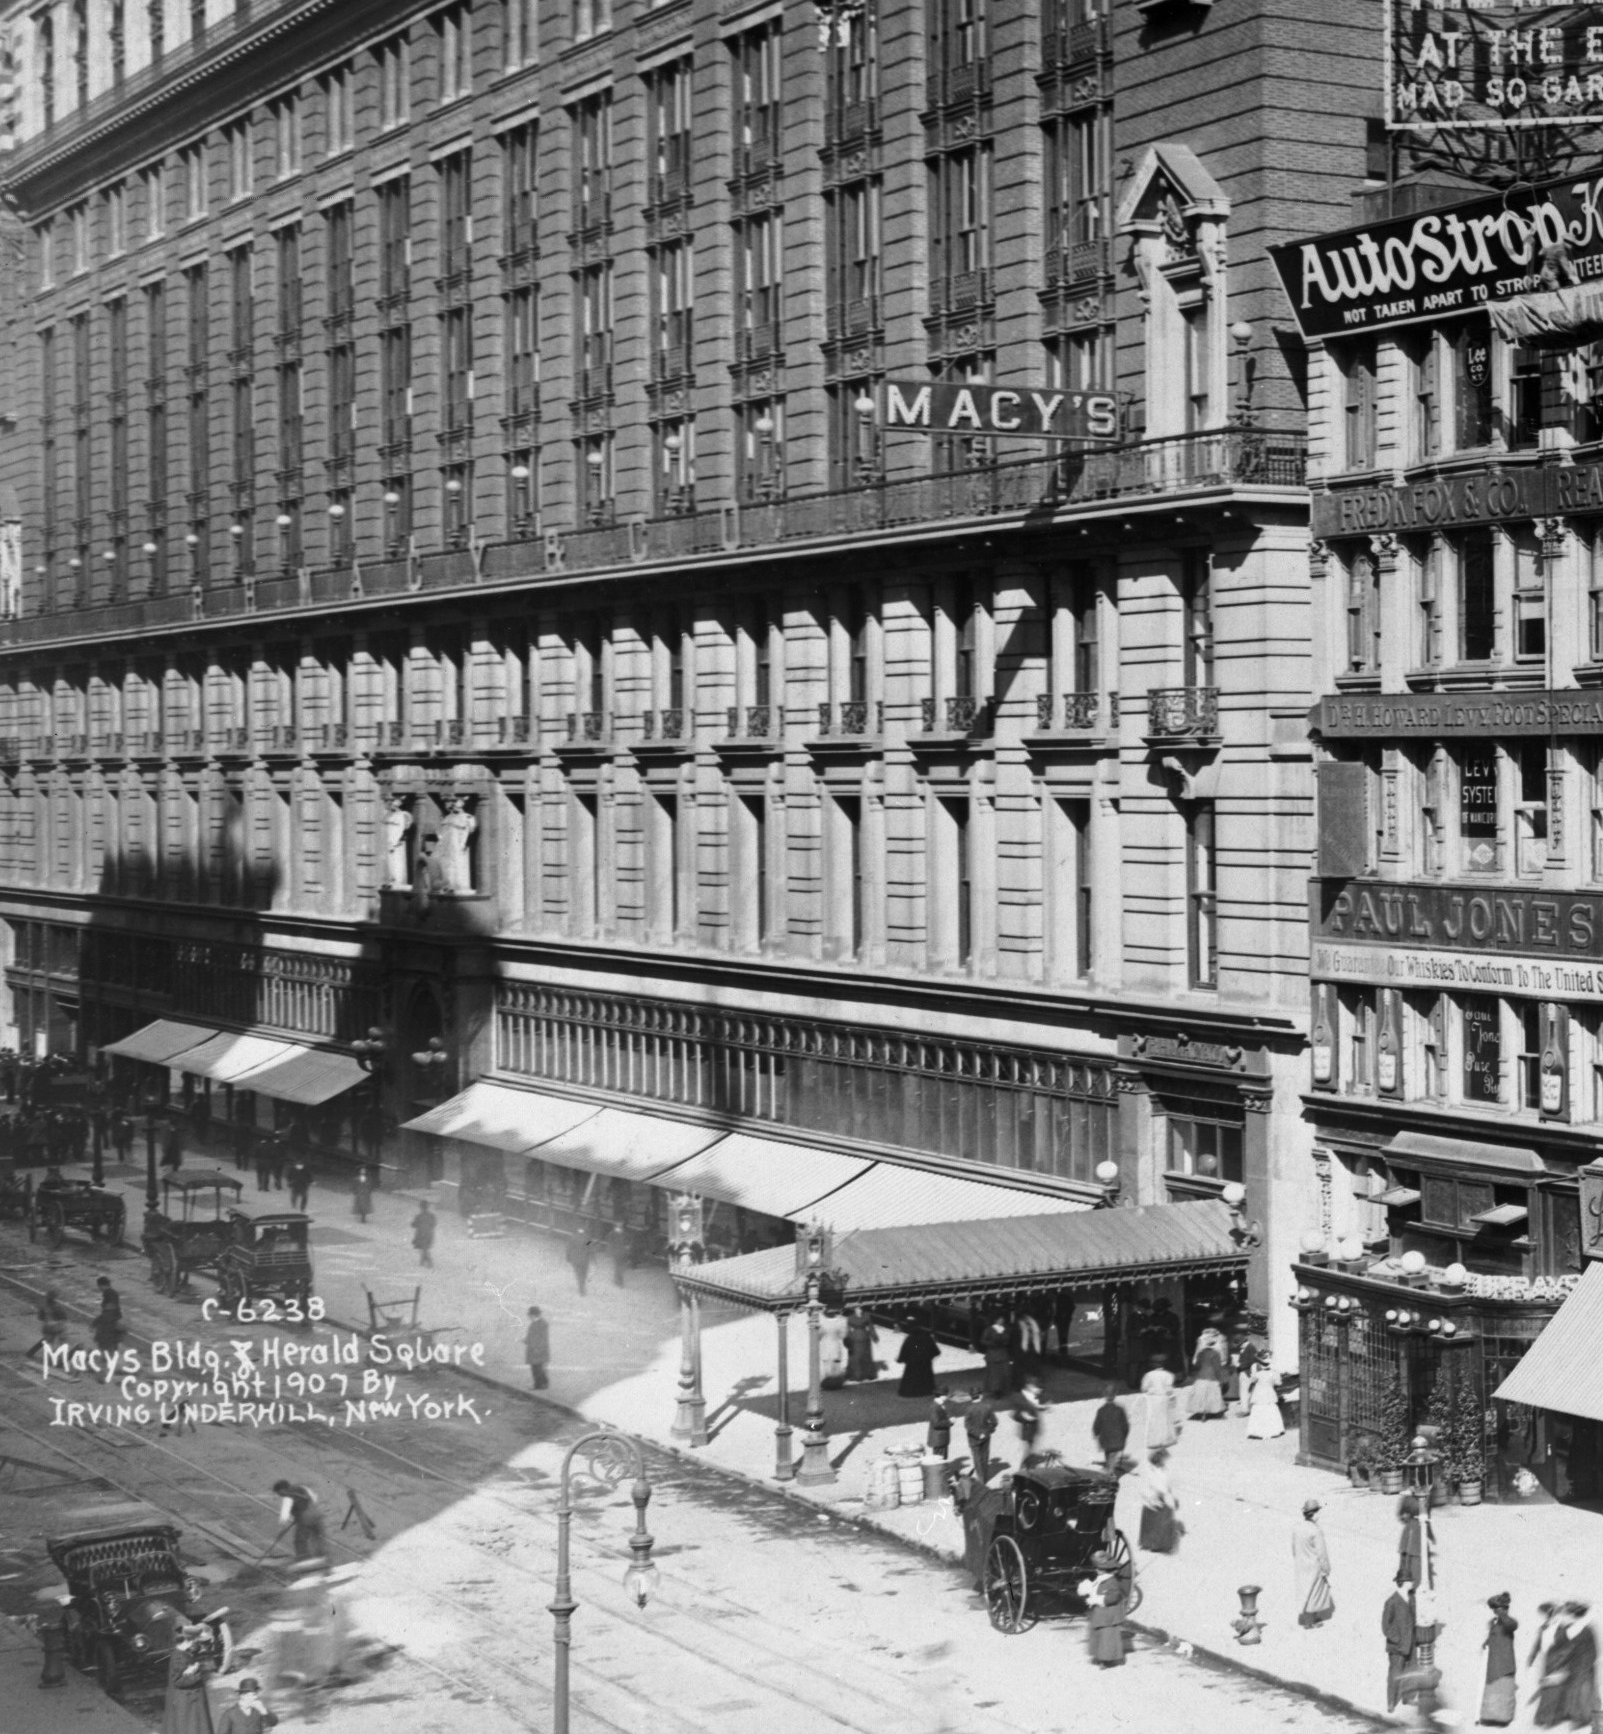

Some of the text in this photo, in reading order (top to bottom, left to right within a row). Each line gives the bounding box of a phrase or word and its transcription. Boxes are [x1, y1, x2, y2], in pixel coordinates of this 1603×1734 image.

[1416, 31, 1463, 70] AT
[1486, 26, 1564, 66] THE
[1395, 77, 1465, 111] MAD
[1485, 77, 1526, 108] SQ
[1343, 308, 1367, 325] NOT
[1373, 299, 1416, 318] TAKEN
[1423, 290, 1463, 309] APART
[1470, 285, 1489, 300] TO
[1468, 347, 1486, 364] Lee
[887, 385, 1116, 436] MACY'S
[1341, 488, 1402, 531] FRED'K
[1412, 483, 1456, 524] FOX
[1464, 481, 1480, 517] &
[1372, 704, 1439, 727] HOWARD
[1493, 702, 1534, 726] FOOT
[1331, 892, 1431, 937] PAUL
[1443, 897, 1594, 949] JONES
[1457, 960, 1471, 980] To
[1468, 962, 1513, 986] Conform
[1517, 966, 1529, 988] To
[1530, 966, 1553, 990] The
[1555, 968, 1594, 993] United
[1465, 1052, 1490, 1073] Pure
